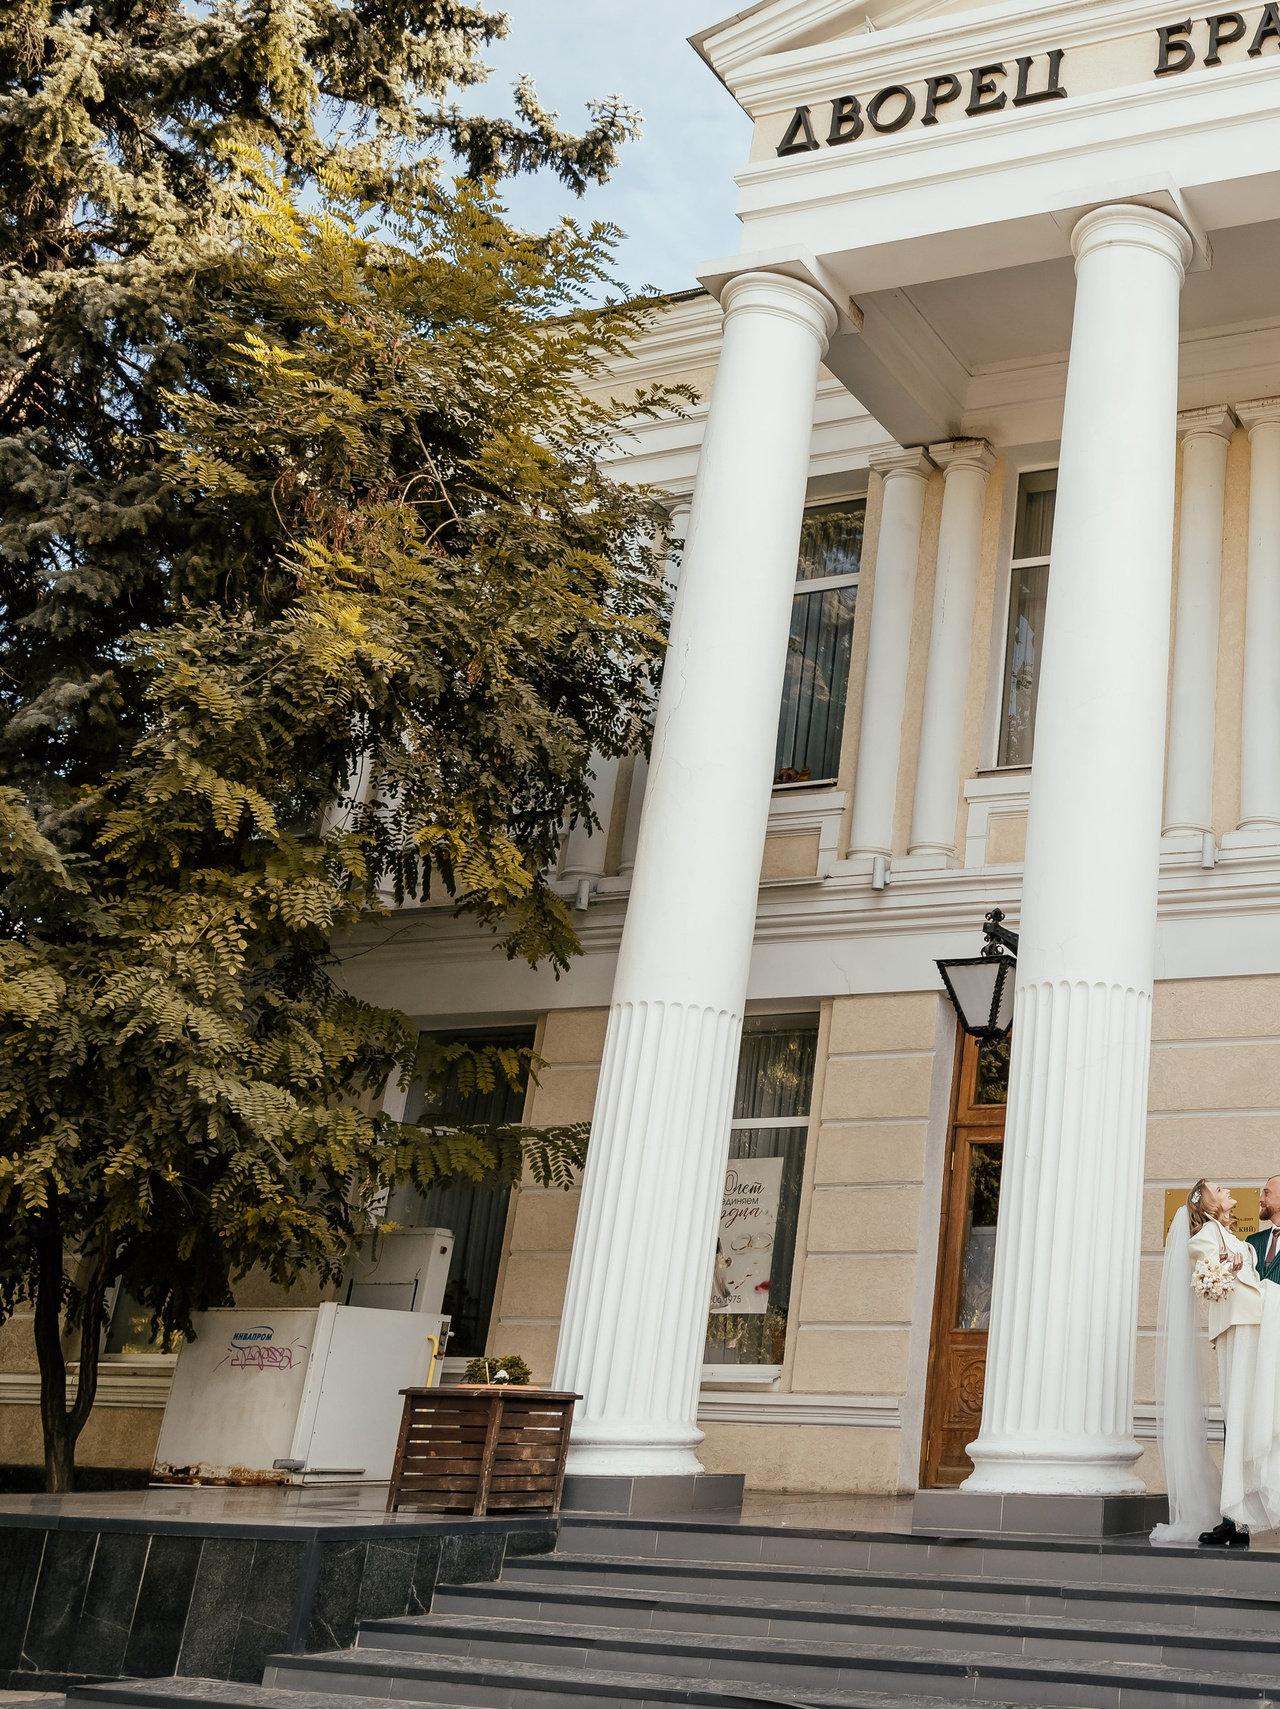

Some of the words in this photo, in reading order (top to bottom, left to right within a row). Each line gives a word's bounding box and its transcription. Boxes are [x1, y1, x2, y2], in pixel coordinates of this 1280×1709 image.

[775, 48, 1068, 157] ДВОРЕЦ
[733, 1181, 765, 1195] лет
[233, 1332, 274, 1341] ИНВАПРОМ
